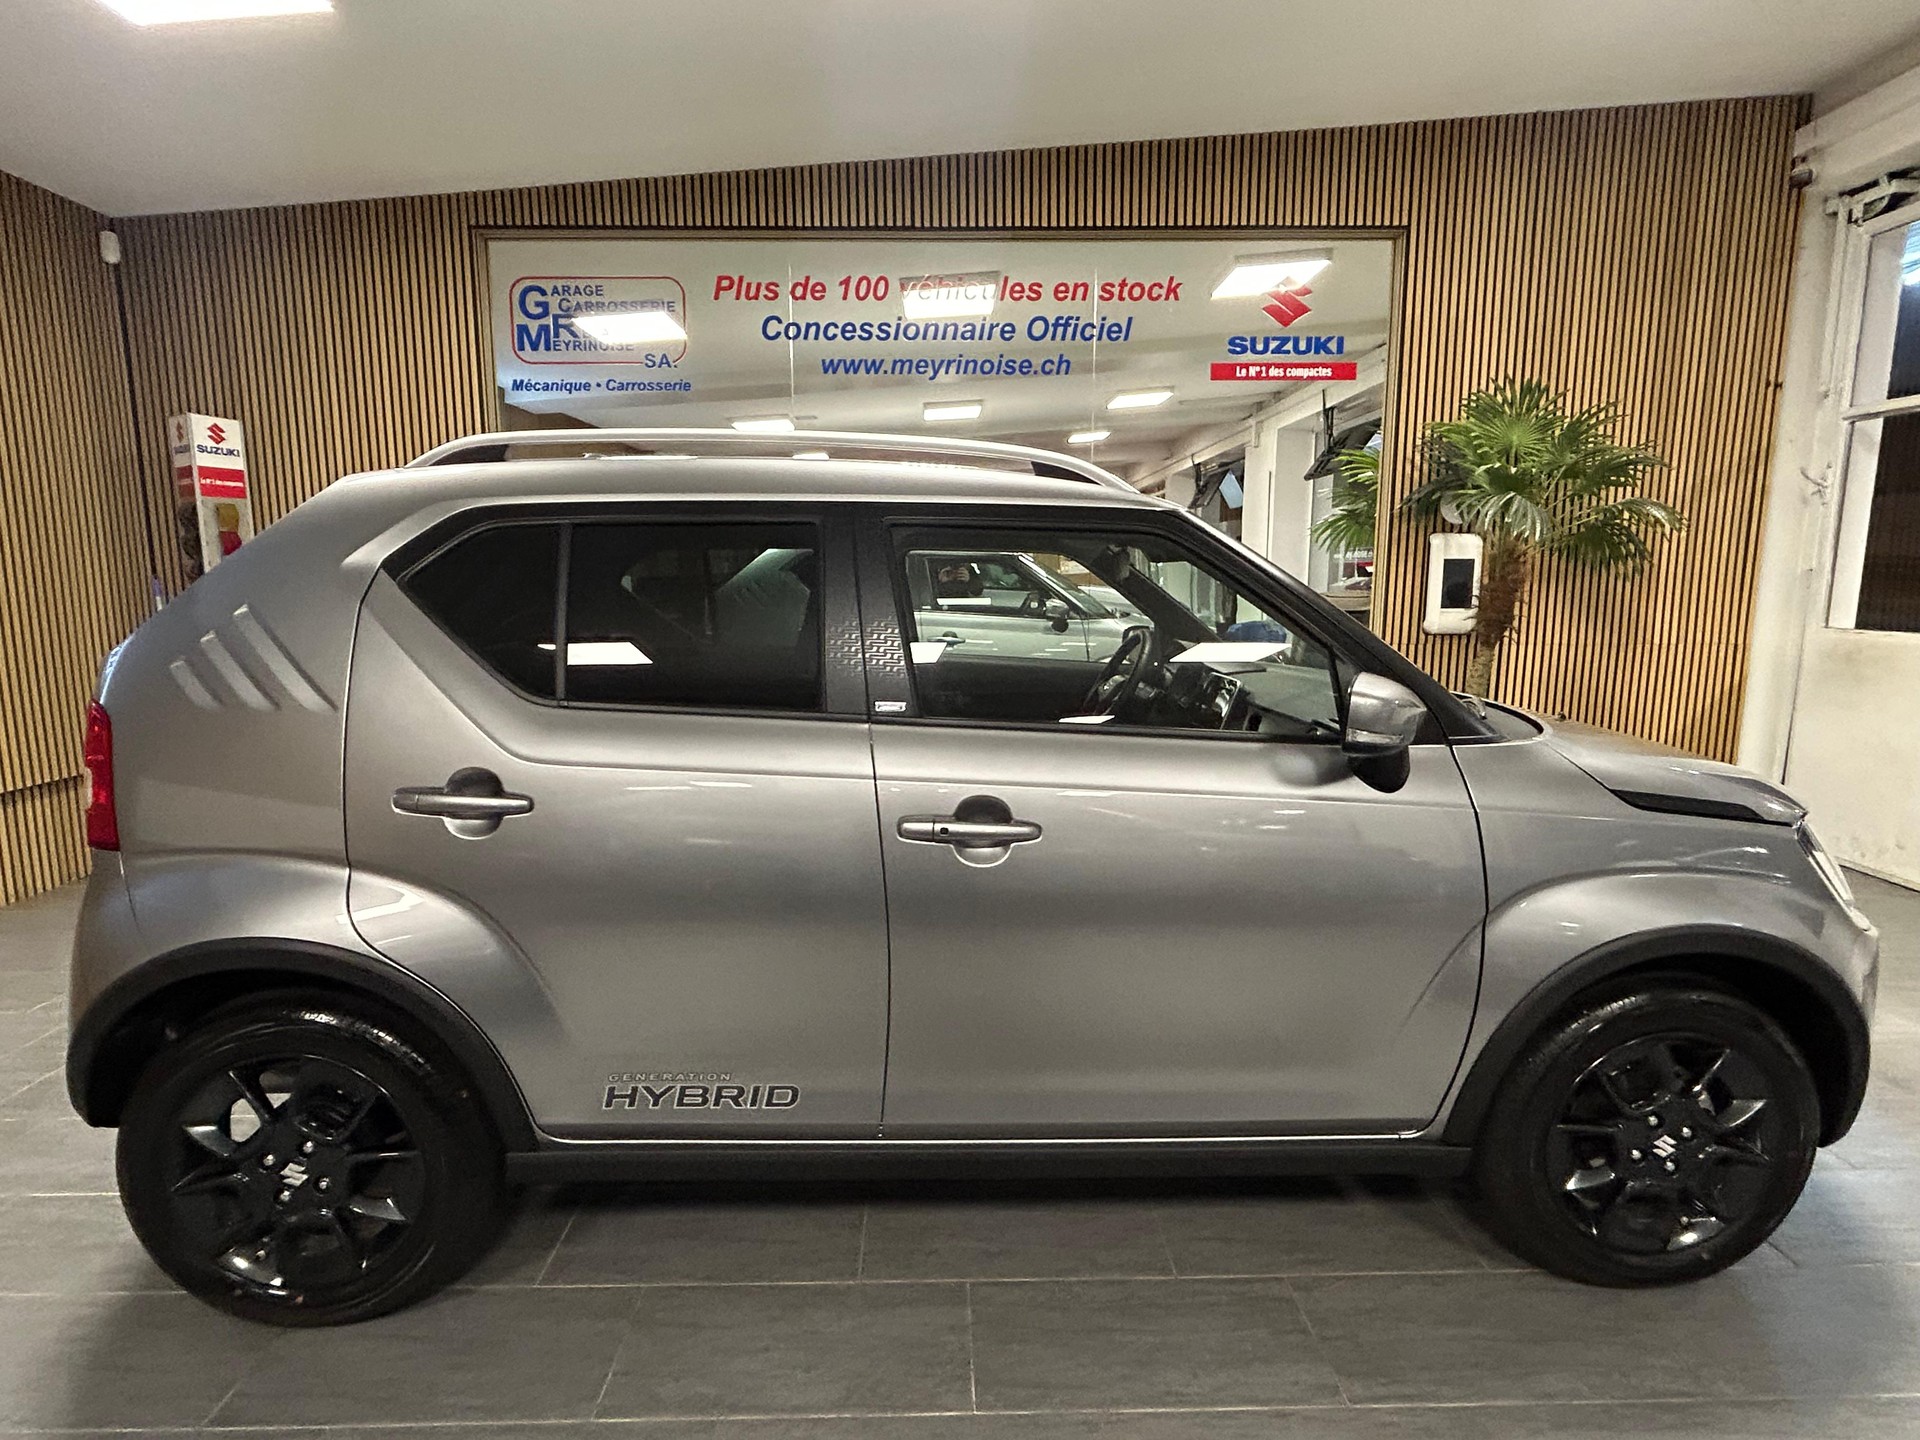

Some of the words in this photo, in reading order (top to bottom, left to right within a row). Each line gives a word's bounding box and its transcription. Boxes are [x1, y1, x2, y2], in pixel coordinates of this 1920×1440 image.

[713, 275, 780, 301] Plus
[790, 275, 827, 301] de
[838, 275, 890, 301] 100
[1053, 281, 1089, 301] en
[1098, 275, 1183, 301] stock
[761, 315, 1016, 341] Concessionnaire
[1026, 315, 1133, 341] Officiel
[1227, 335, 1345, 355] SUZUKI
[821, 353, 1071, 381] www.meyrinoise.ch
[1236, 365, 1247, 378] Le
[1268, 365, 1285, 378] des
[1286, 365, 1333, 380] compactes
[511, 378, 591, 394] Mécanique
[605, 378, 692, 392] Carrosserie
[196, 444, 240, 458] SUZUKI
[608, 1072, 732, 1082] GENERATION
[602, 1083, 800, 1110] HYBRID
